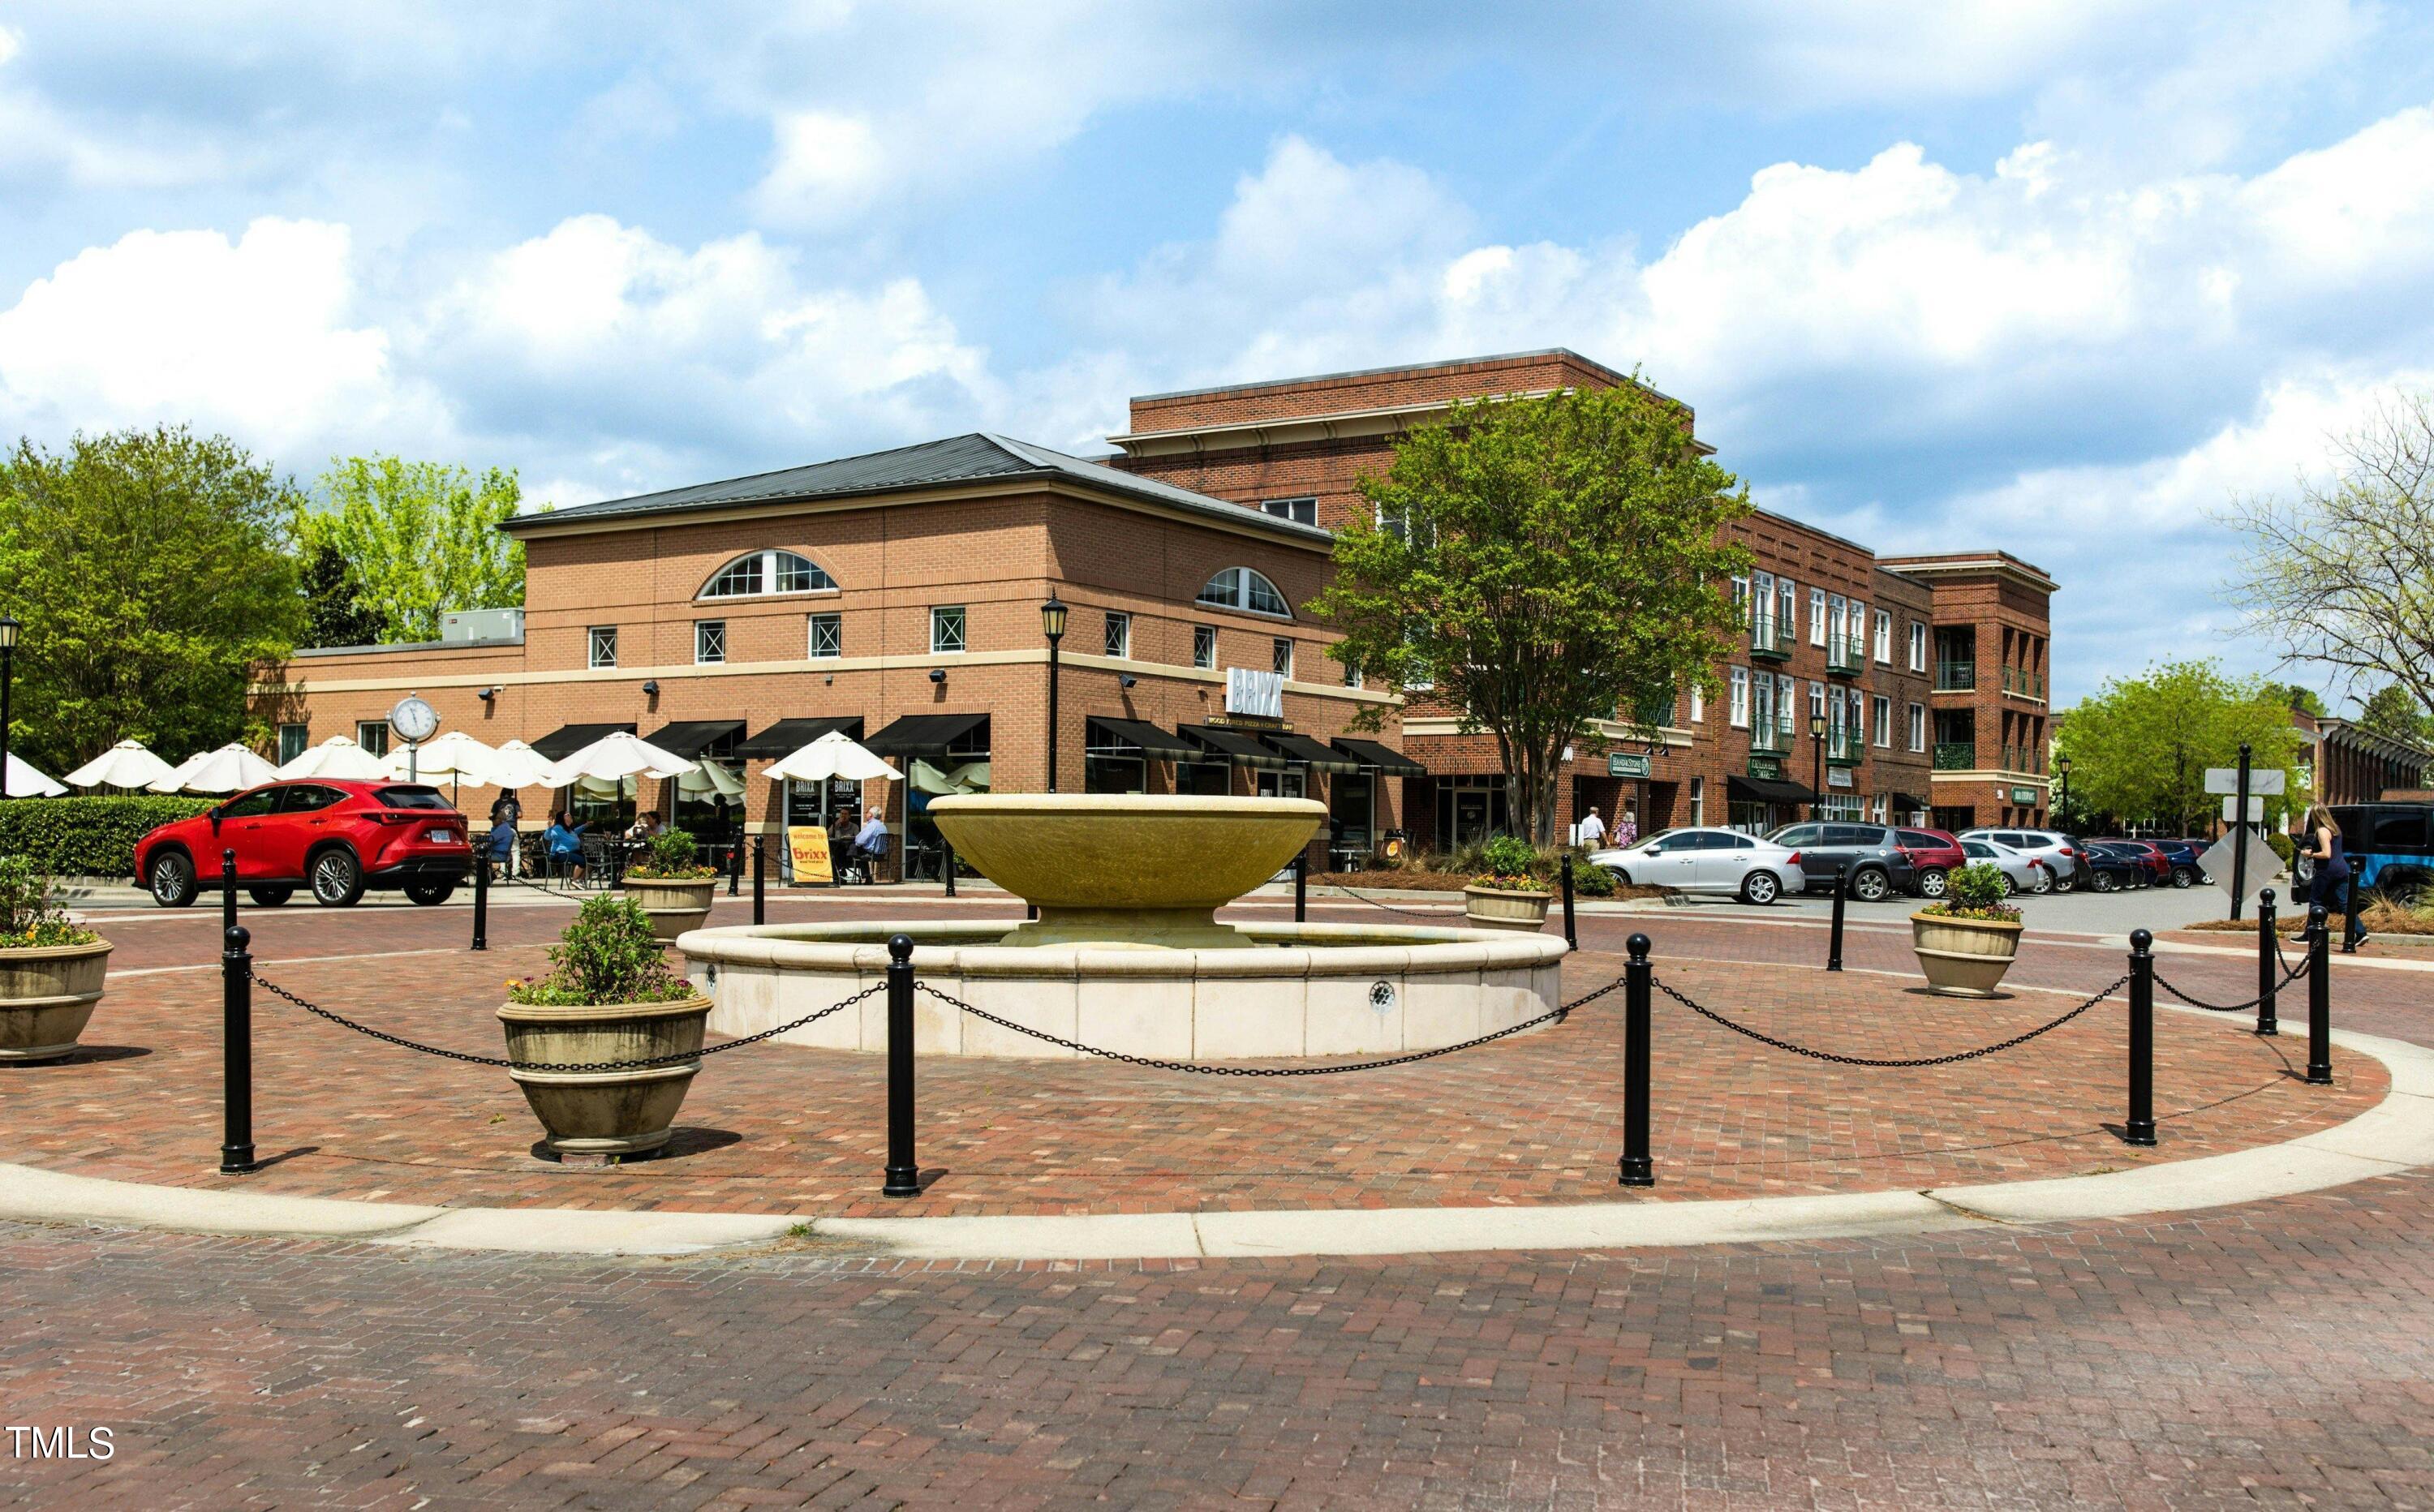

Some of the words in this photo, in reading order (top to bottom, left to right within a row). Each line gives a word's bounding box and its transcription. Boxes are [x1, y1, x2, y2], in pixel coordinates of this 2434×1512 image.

[1226, 667, 1284, 718] BRIXX
[796, 780, 815, 793] BRIXX
[834, 780, 854, 793] BRIXX
[793, 848, 828, 860] Brixx
